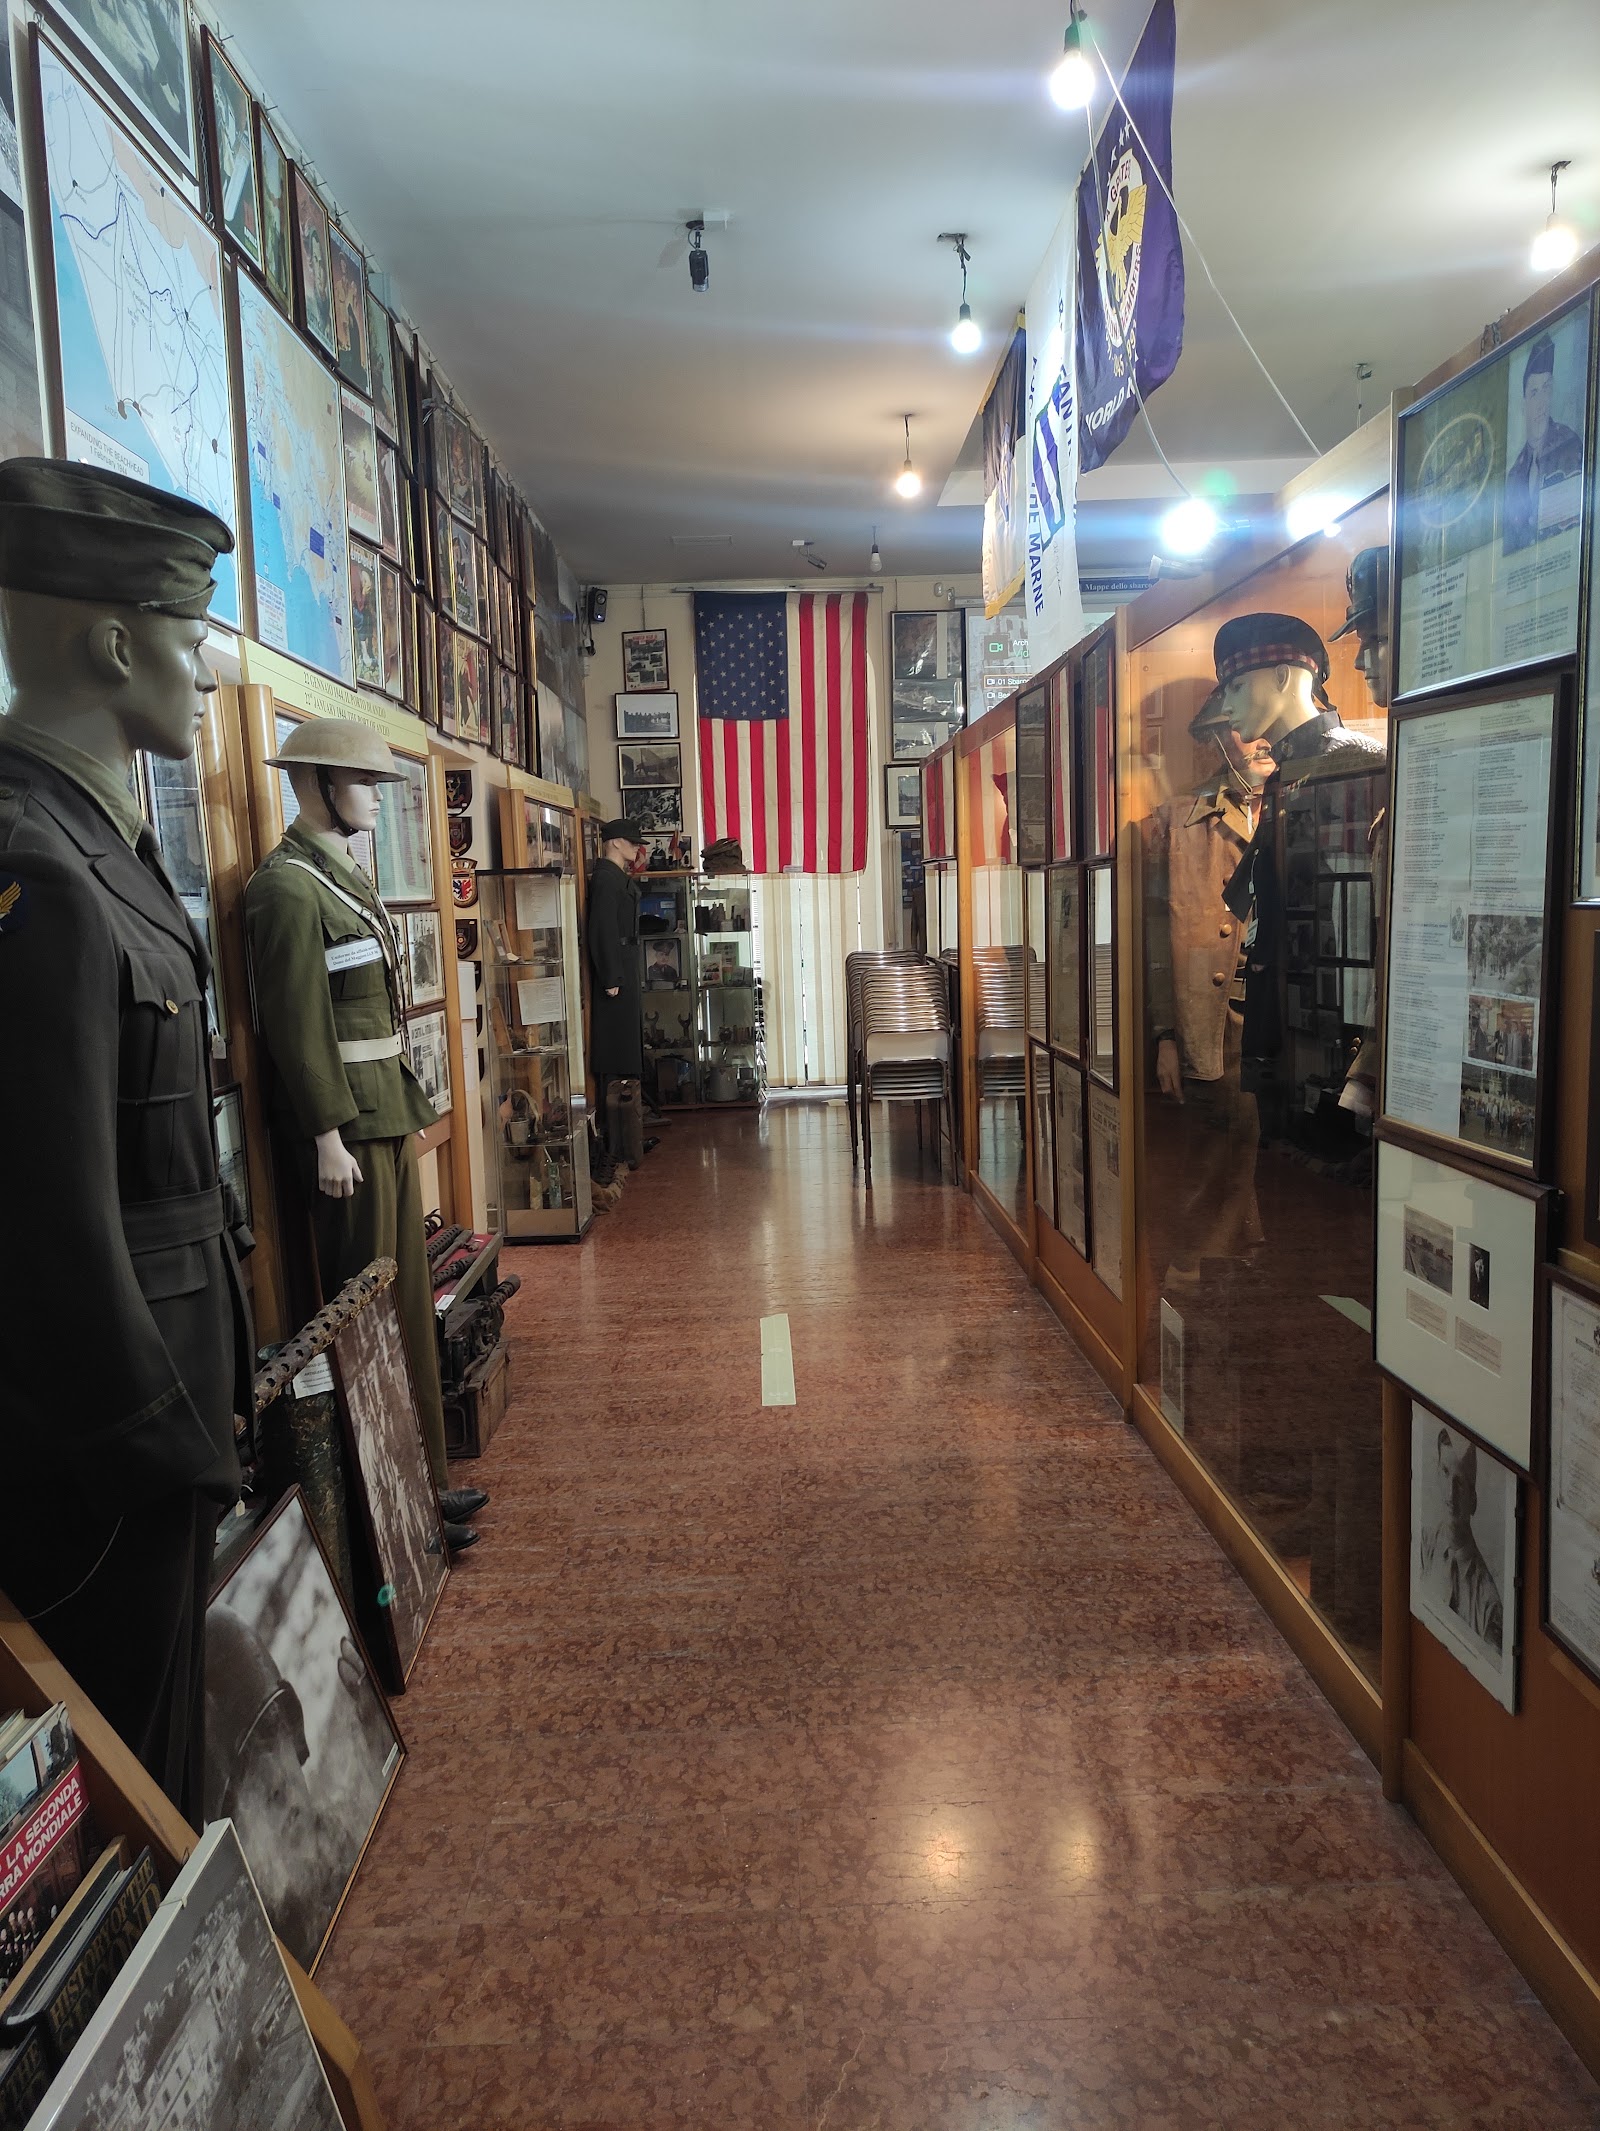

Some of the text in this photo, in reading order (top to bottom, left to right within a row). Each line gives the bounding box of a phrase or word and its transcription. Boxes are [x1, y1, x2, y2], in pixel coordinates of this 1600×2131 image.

[70, 422, 144, 477] EXPANDING THE BEACHHEAD
[1029, 532, 1044, 617] MARNE
[1085, 582, 1110, 592] Mappe
[1111, 582, 1128, 590] dello
[6, 1777, 80, 1870] LA SECONDA
[23, 1790, 83, 1870] MONDIALE
[50, 1856, 155, 2027] HISTORY OF THE
